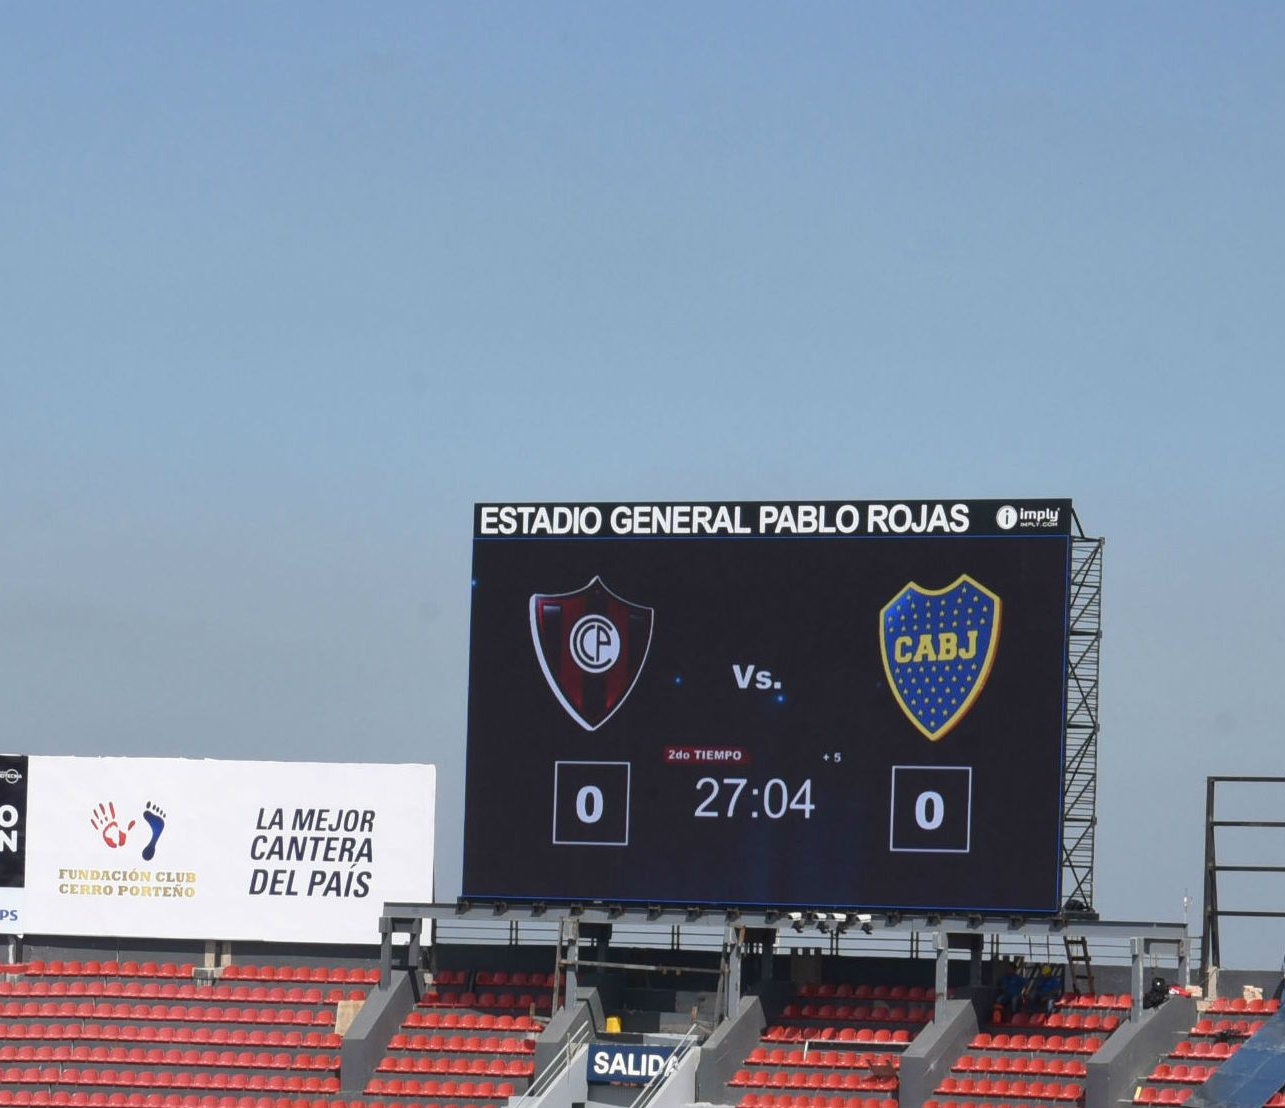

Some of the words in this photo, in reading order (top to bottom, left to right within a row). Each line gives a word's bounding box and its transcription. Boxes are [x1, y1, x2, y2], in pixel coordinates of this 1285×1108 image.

[481, 506, 602, 535] ESTADIO
[610, 505, 751, 534] GENERAL
[759, 504, 859, 534] PABLO
[867, 503, 970, 533] ROJAS
[1020, 507, 1058, 522] imply
[894, 630, 978, 663] CABJ
[732, 664, 782, 689] Vs.
[668, 750, 690, 761] 2do
[694, 750, 742, 761] TIEMPO
[575, 785, 604, 823] 0
[694, 777, 816, 819] 27:04
[915, 791, 945, 830] 0
[256, 808, 284, 830] LA
[292, 808, 375, 832] MEJOR
[250, 835, 373, 862] CANTERA
[58, 868, 152, 882] FUNDACIÓN
[155, 871, 197, 883] CLUB
[249, 868, 298, 896] DEL
[307, 863, 372, 898] PAÍS
[59, 883, 114, 896] CERRO
[117, 883, 196, 898] PORTEÑO
